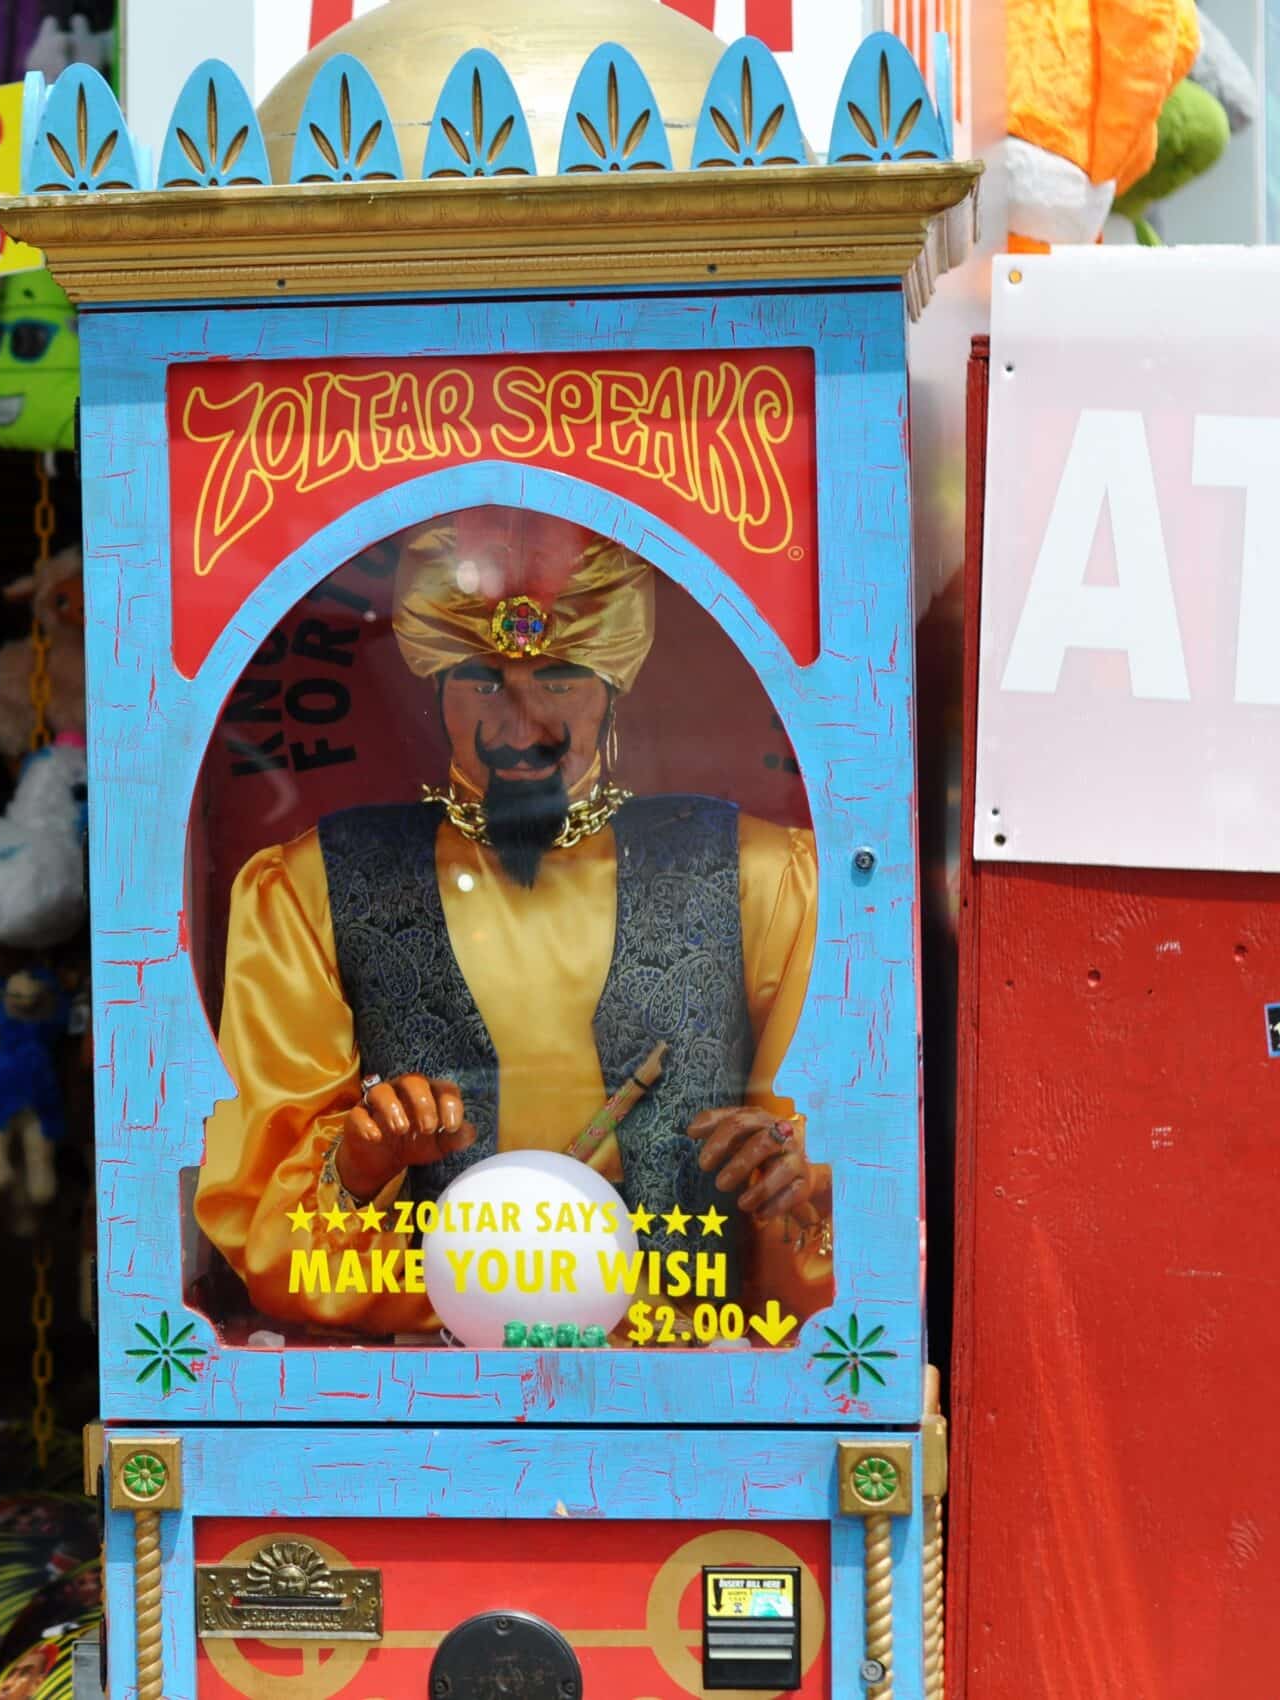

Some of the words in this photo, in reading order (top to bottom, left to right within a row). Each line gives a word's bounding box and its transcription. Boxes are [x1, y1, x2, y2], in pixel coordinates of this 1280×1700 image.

[184, 369, 481, 576] ZOLTAR
[491, 361, 794, 554] SPEAKS
[393, 1201, 521, 1233] ZOLTAR
[535, 1202, 618, 1233] SAYS
[288, 1249, 427, 1294] MAKE
[447, 1249, 577, 1294] YOUR
[597, 1250, 727, 1297] WISH
[627, 1300, 745, 1345] $2.00
